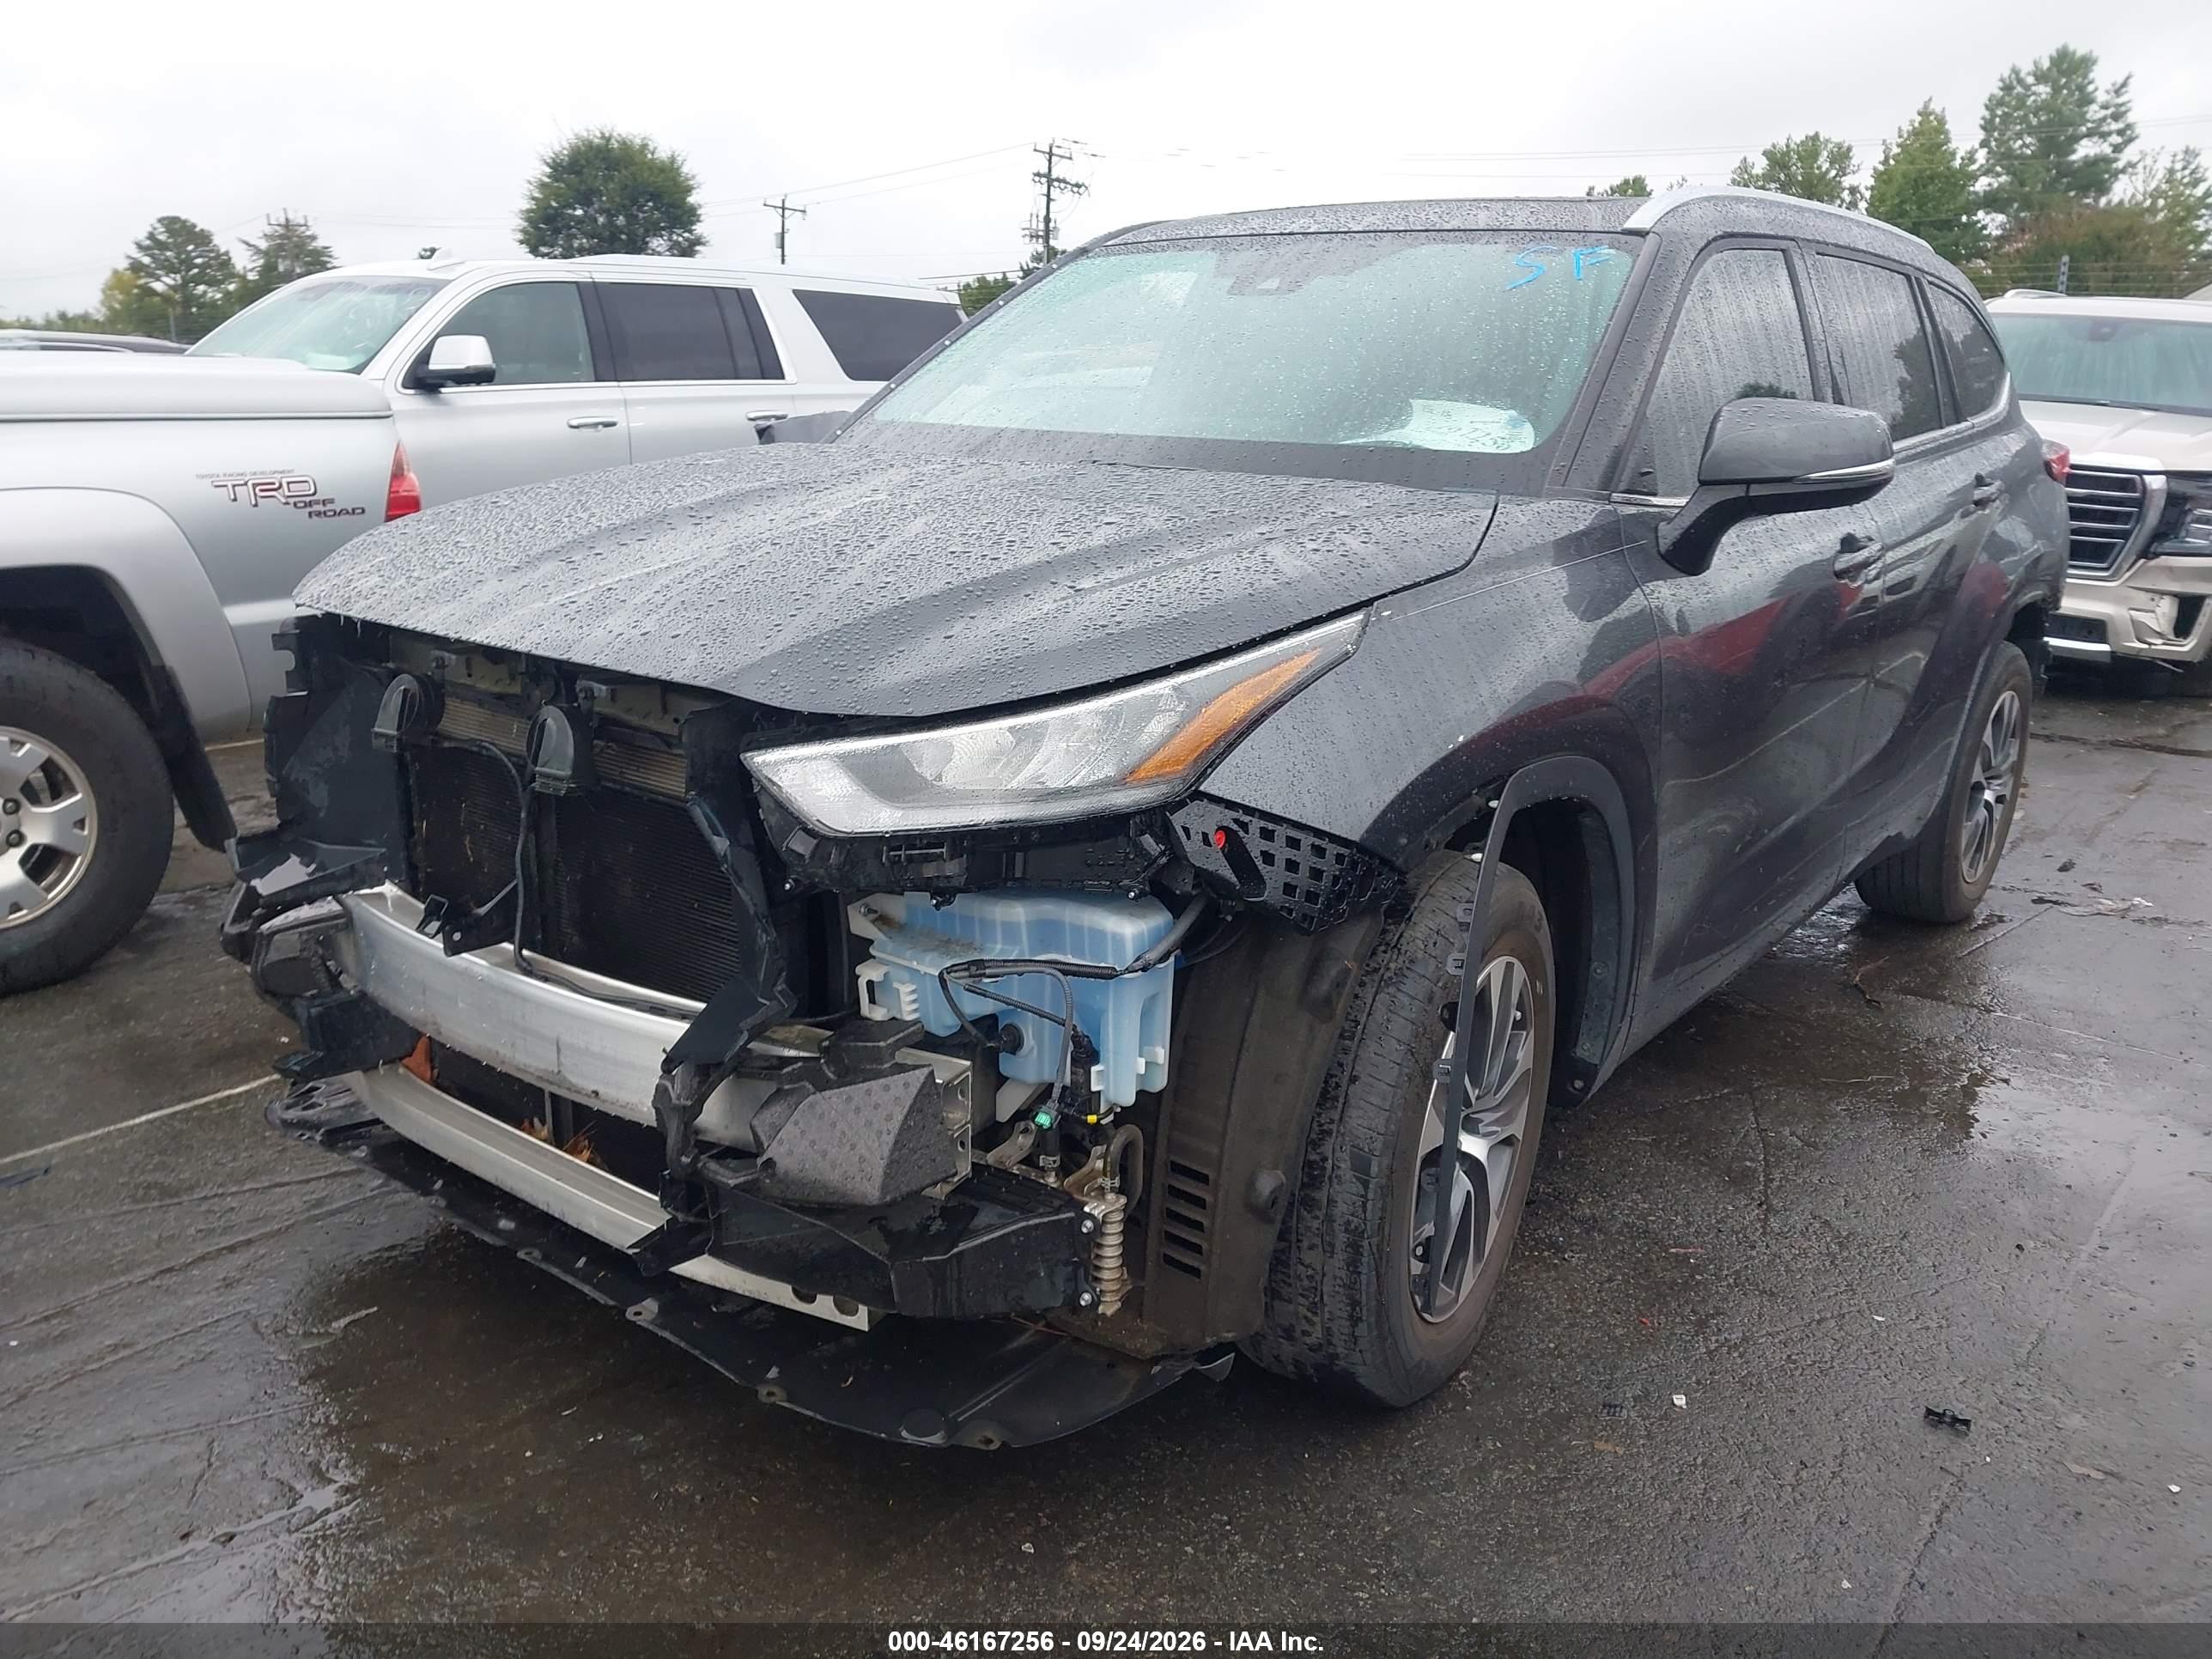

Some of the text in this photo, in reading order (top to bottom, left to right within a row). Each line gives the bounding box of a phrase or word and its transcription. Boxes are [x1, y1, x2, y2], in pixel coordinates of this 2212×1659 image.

[211, 474, 318, 507] TRD
[293, 498, 336, 509] OFF
[307, 507, 366, 519] ROAD
